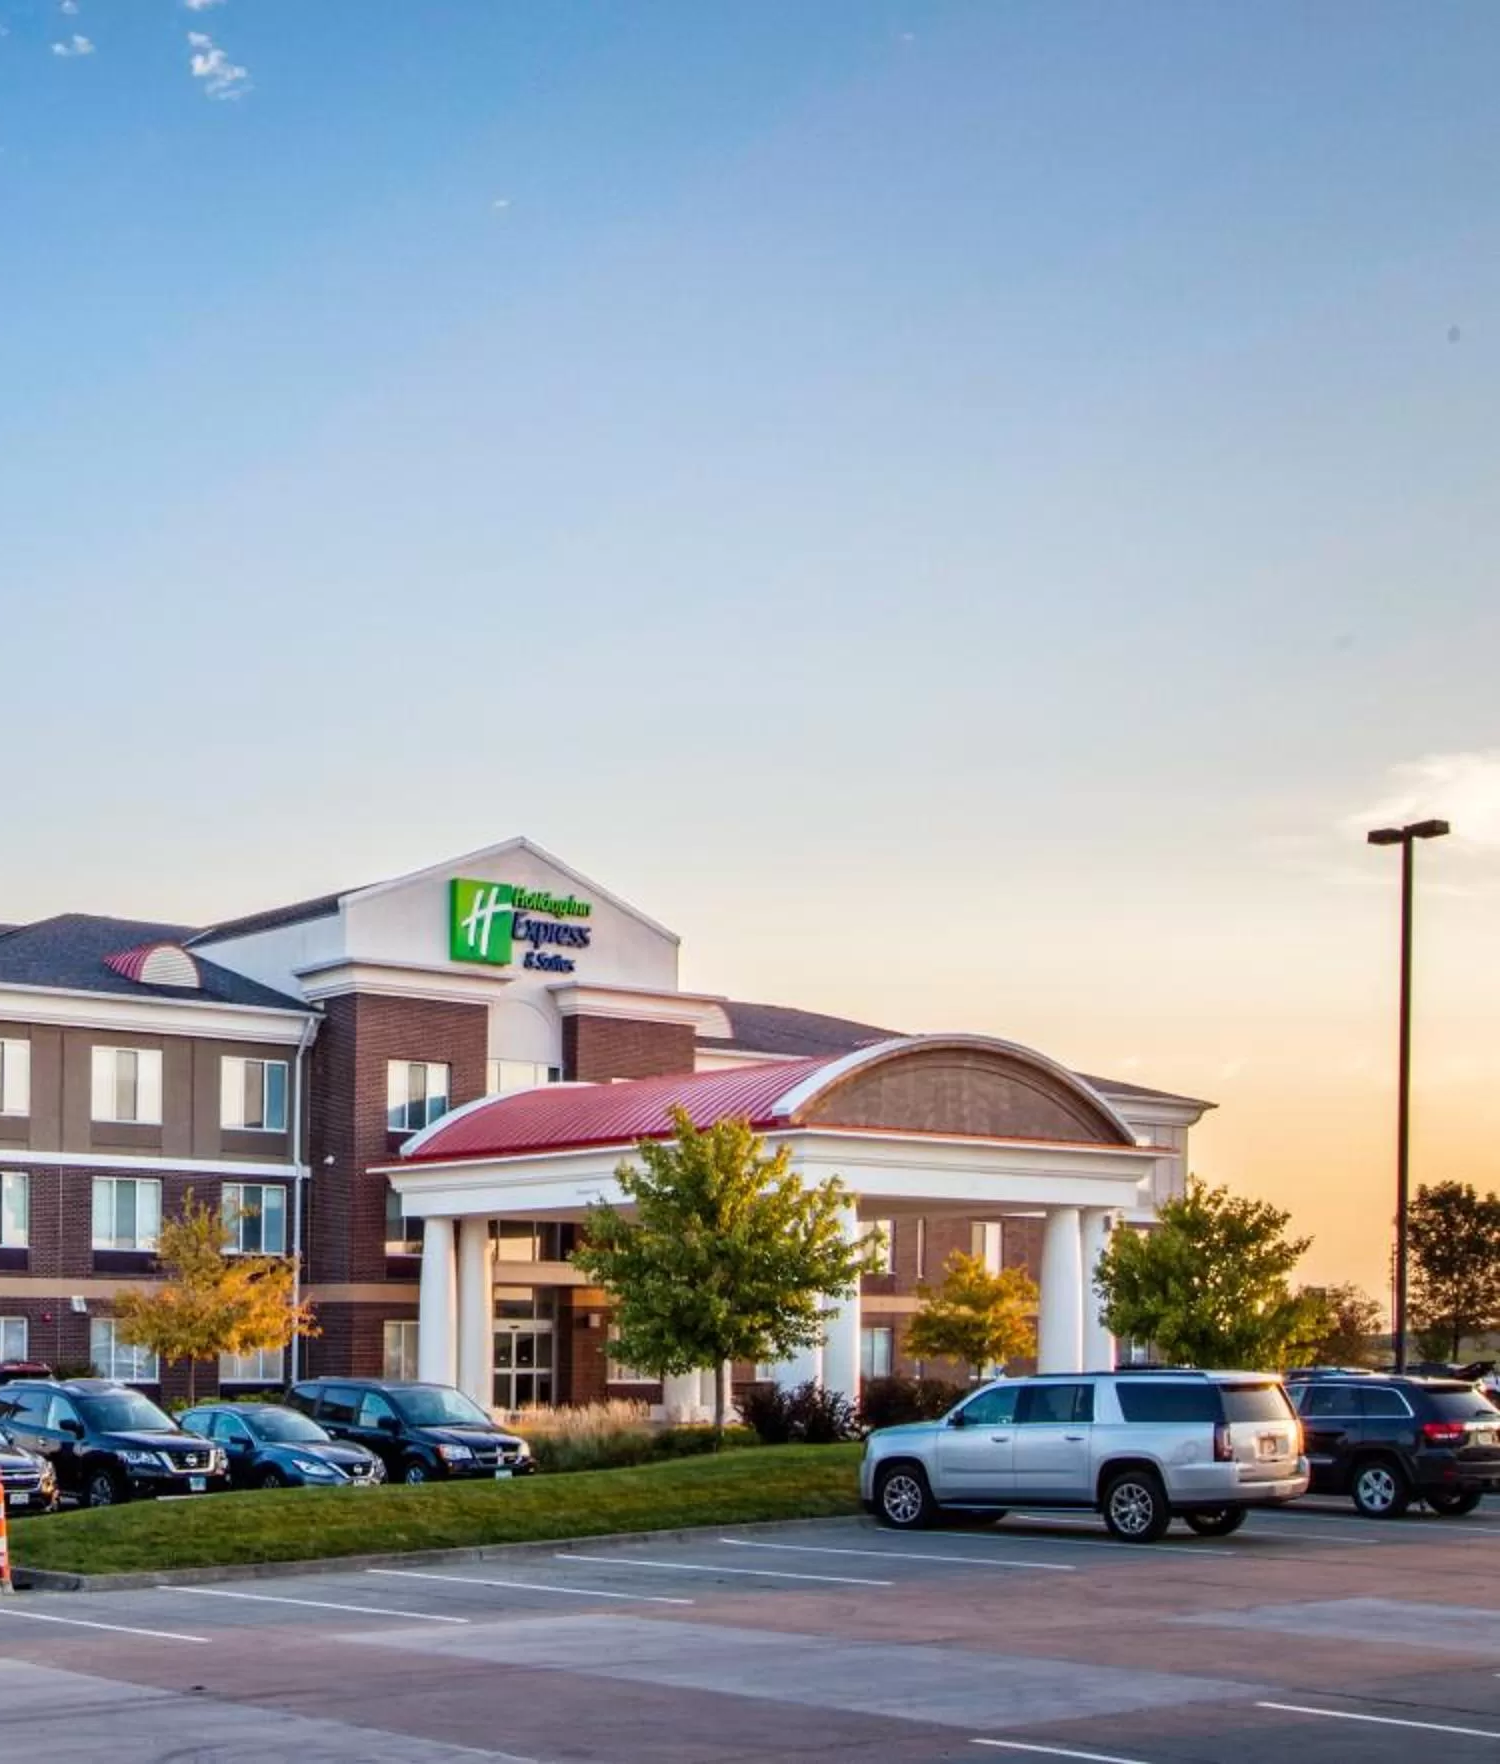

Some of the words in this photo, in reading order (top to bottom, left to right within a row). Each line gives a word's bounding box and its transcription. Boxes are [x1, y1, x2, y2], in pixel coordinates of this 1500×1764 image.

[511, 887, 567, 918] Holiday
[566, 894, 591, 916] Inn
[511, 911, 591, 949] Express
[523, 951, 535, 969] &
[536, 952, 575, 973] Suites
